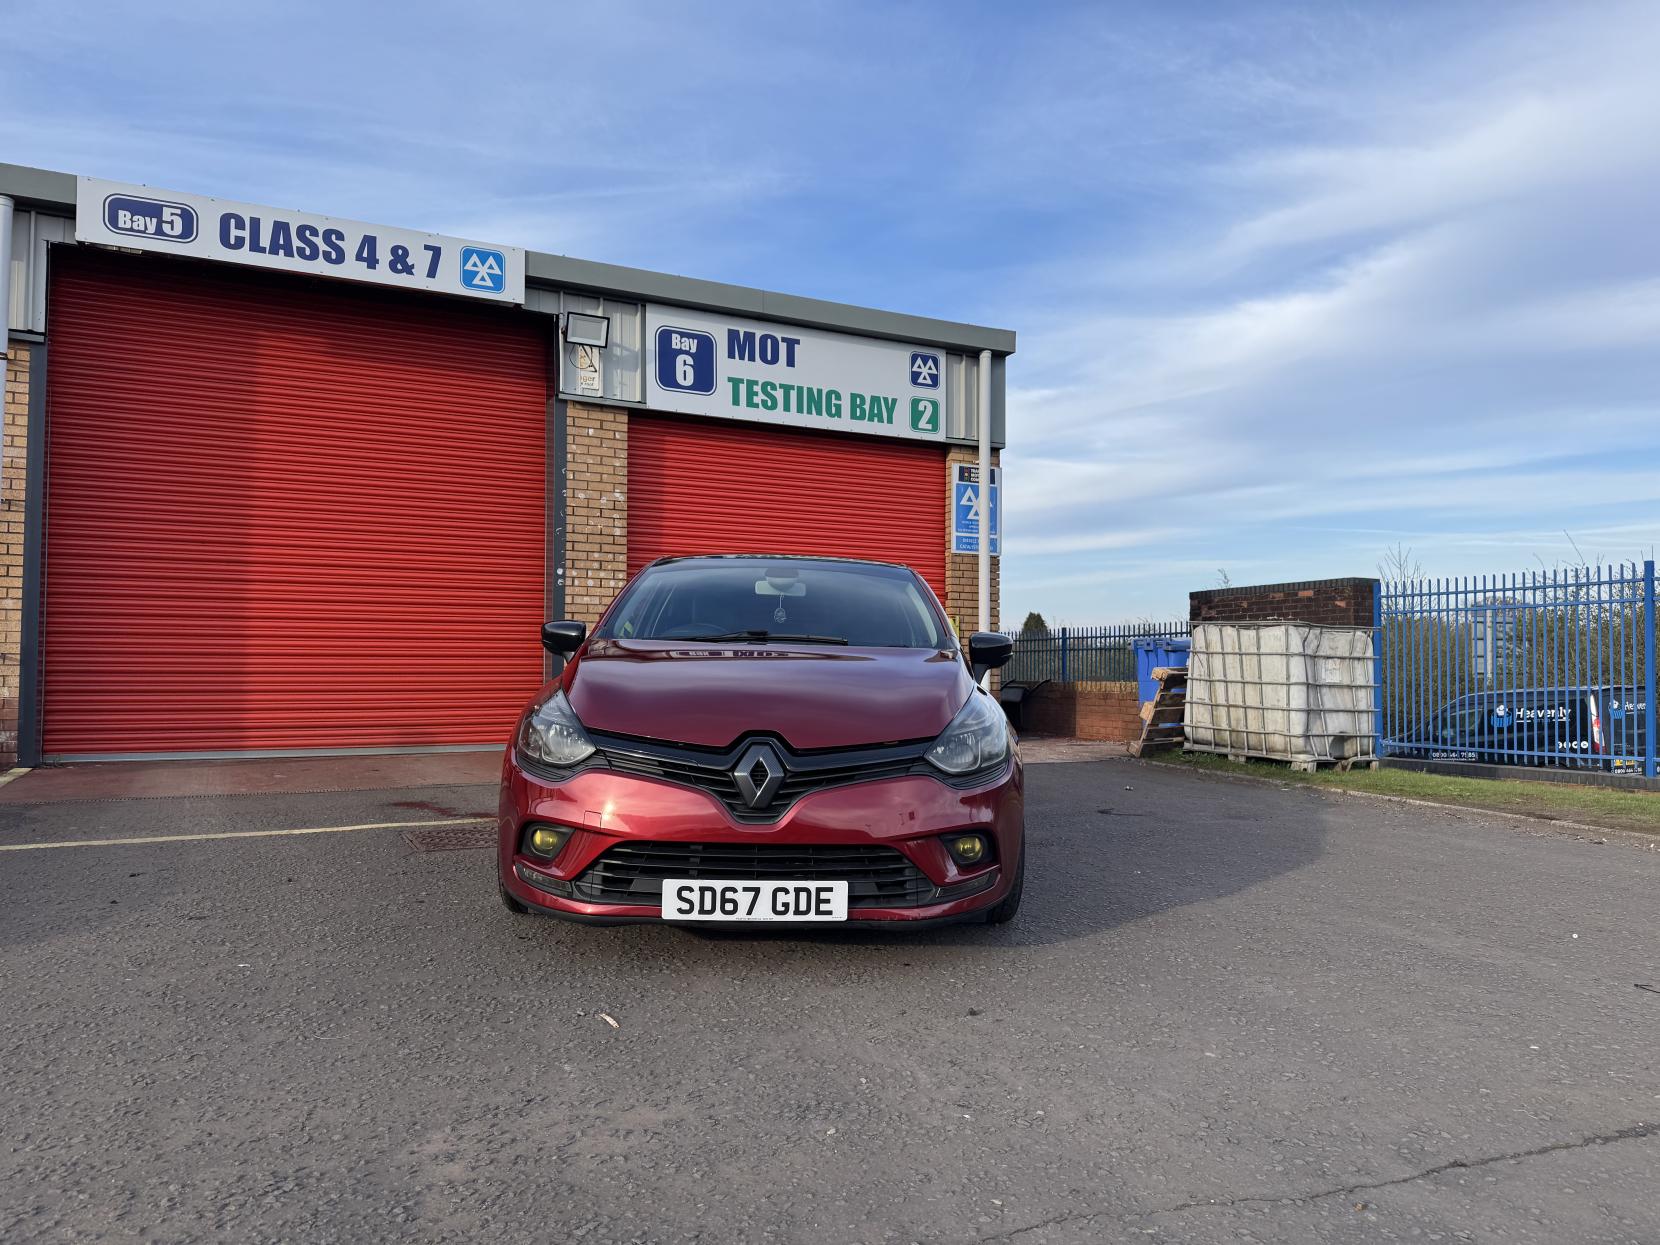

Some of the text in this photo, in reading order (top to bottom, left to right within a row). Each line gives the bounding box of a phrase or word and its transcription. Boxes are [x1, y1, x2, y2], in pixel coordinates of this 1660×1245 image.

[117, 207, 183, 236] Bay 5
[219, 212, 442, 279] CLASS 4 & 7
[671, 333, 698, 353] Bay
[727, 328, 801, 368] MOT
[675, 354, 695, 387] 6
[727, 376, 898, 425] TESTING BAY
[917, 400, 933, 430] 2
[1515, 706, 1572, 720] Heavenly
[676, 885, 834, 916] SD67 GDE
